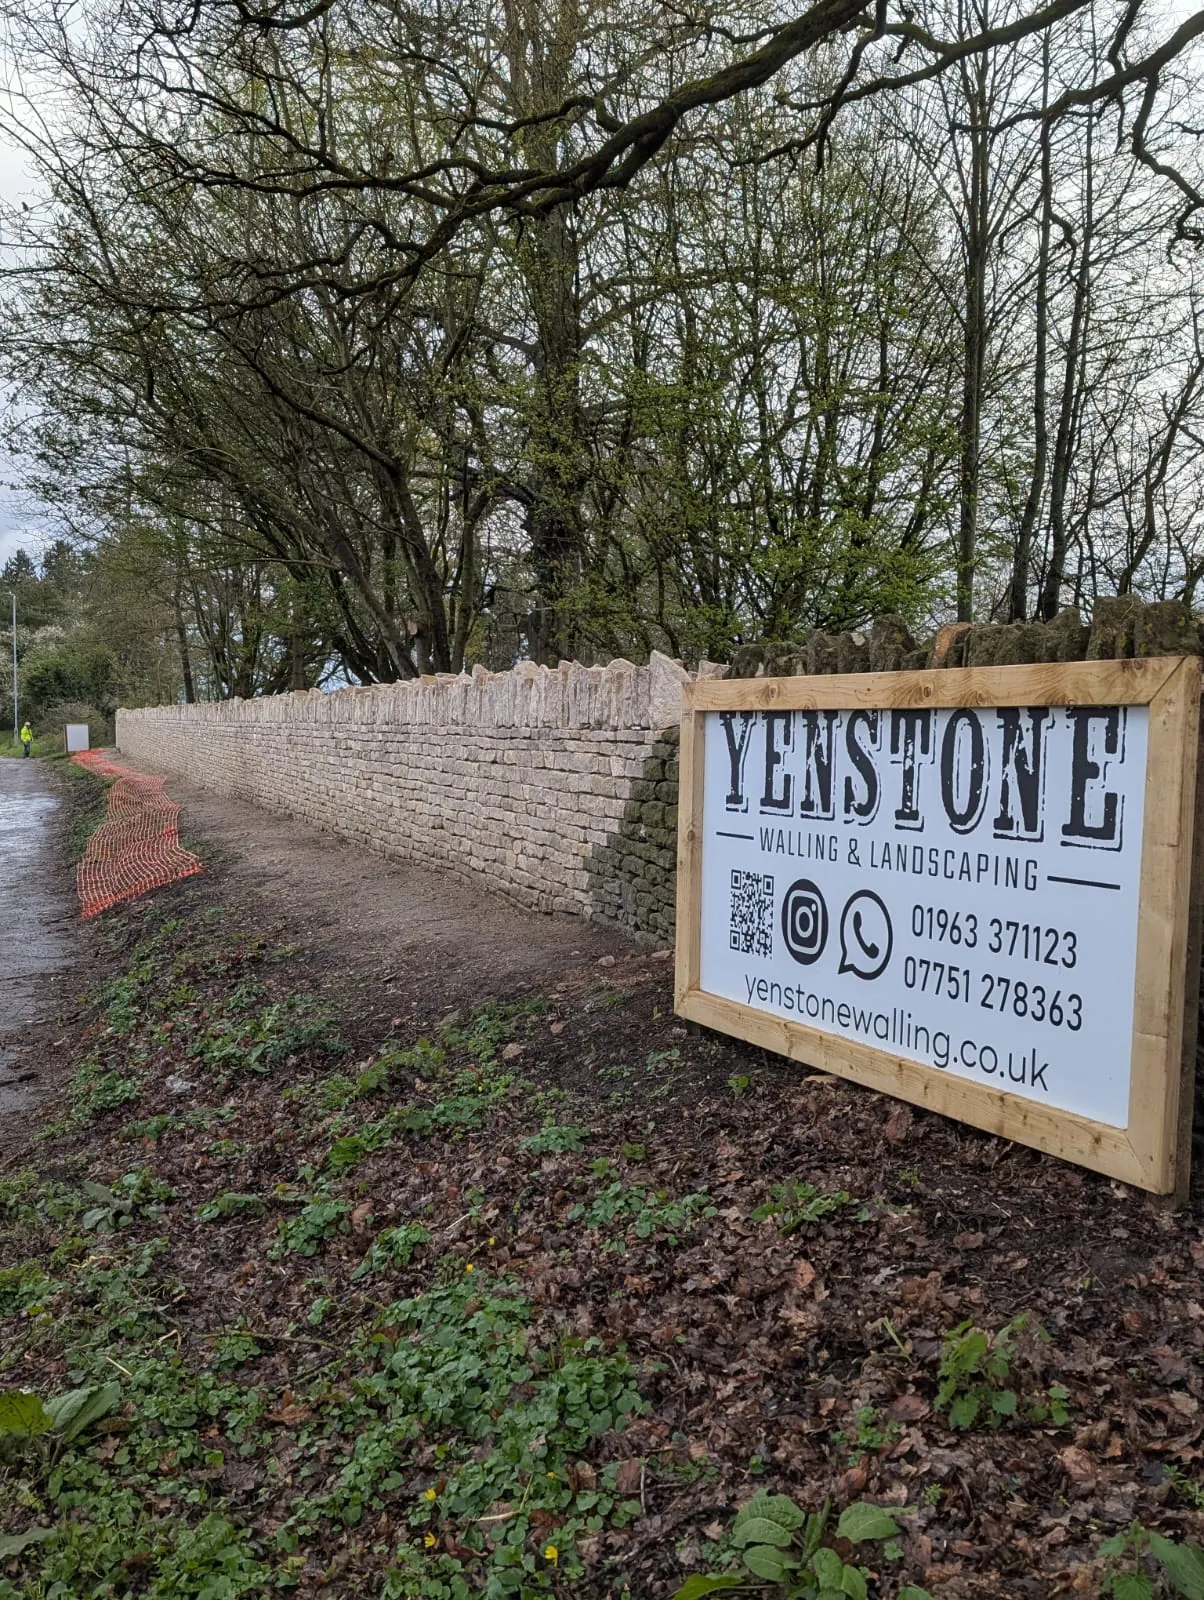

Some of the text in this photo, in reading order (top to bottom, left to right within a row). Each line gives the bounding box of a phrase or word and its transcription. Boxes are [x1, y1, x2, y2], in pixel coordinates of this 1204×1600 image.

[719, 706, 1128, 853] YENSTONE
[759, 826, 1038, 892] WALLING & LANDSCAPING
[911, 904, 1077, 969] 01963 371123
[904, 955, 1083, 1032] 07751 278363
[744, 974, 1049, 1092] yenstonewalling.co.uk
